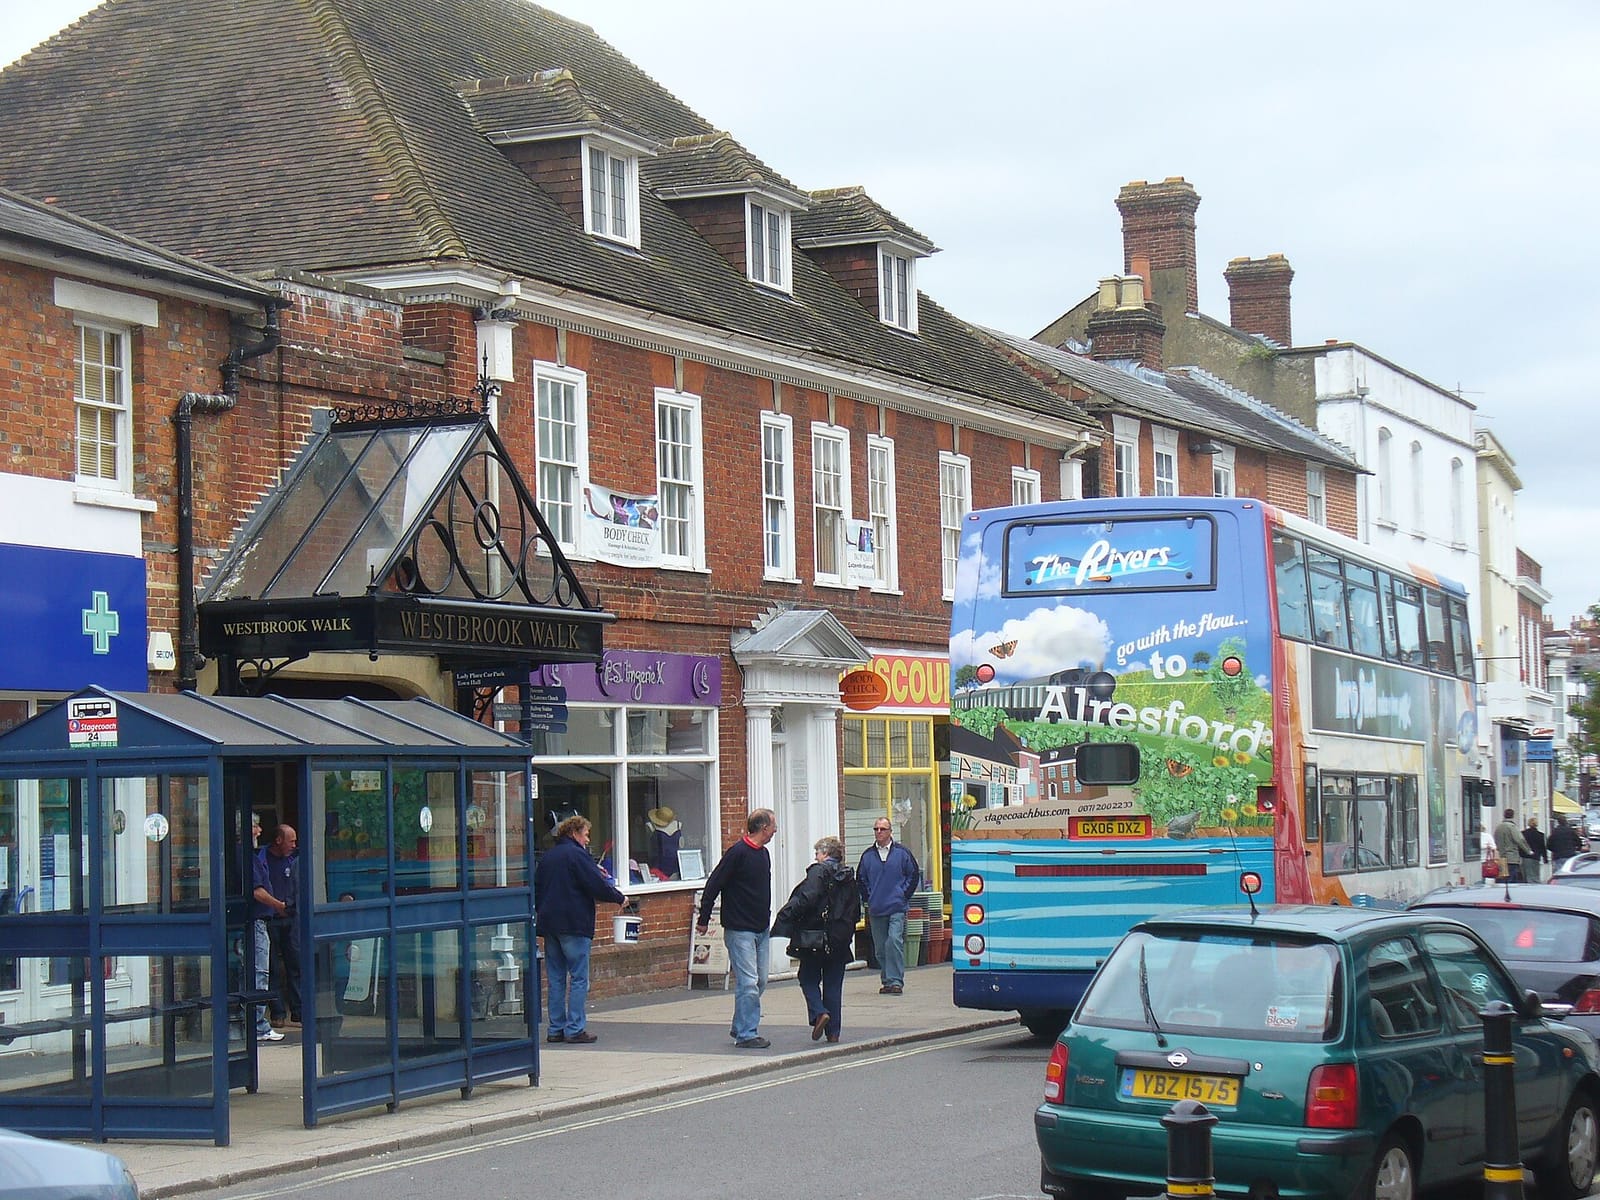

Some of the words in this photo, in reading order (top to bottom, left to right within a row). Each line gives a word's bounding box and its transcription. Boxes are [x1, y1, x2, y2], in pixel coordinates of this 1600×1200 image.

[604, 527, 627, 541] BODY
[628, 531, 650, 545] CHECK
[1032, 553, 1070, 584] The
[1075, 540, 1171, 585] Rivers
[223, 620, 308, 635] WESTBROOK
[311, 618, 352, 631] WALK
[400, 611, 523, 646] WESTBROOK
[530, 621, 580, 649] WALK
[1116, 643, 1135, 665] go
[1136, 624, 1171, 651] with
[1172, 619, 1197, 640] the
[1149, 651, 1187, 680] to
[845, 684, 880, 693] CHECK
[80, 723, 117, 732] Stagecoach
[1033, 685, 1266, 756] Alresford
[88, 732, 99, 740] 24
[984, 807, 1070, 825] stagecoachbus.com
[1082, 820, 1114, 834] GX06
[1117, 820, 1142, 834] DXZ
[1267, 1015, 1297, 1025] Blood
[1142, 1074, 1179, 1098] YBZ
[1183, 1076, 1230, 1101] 1575
